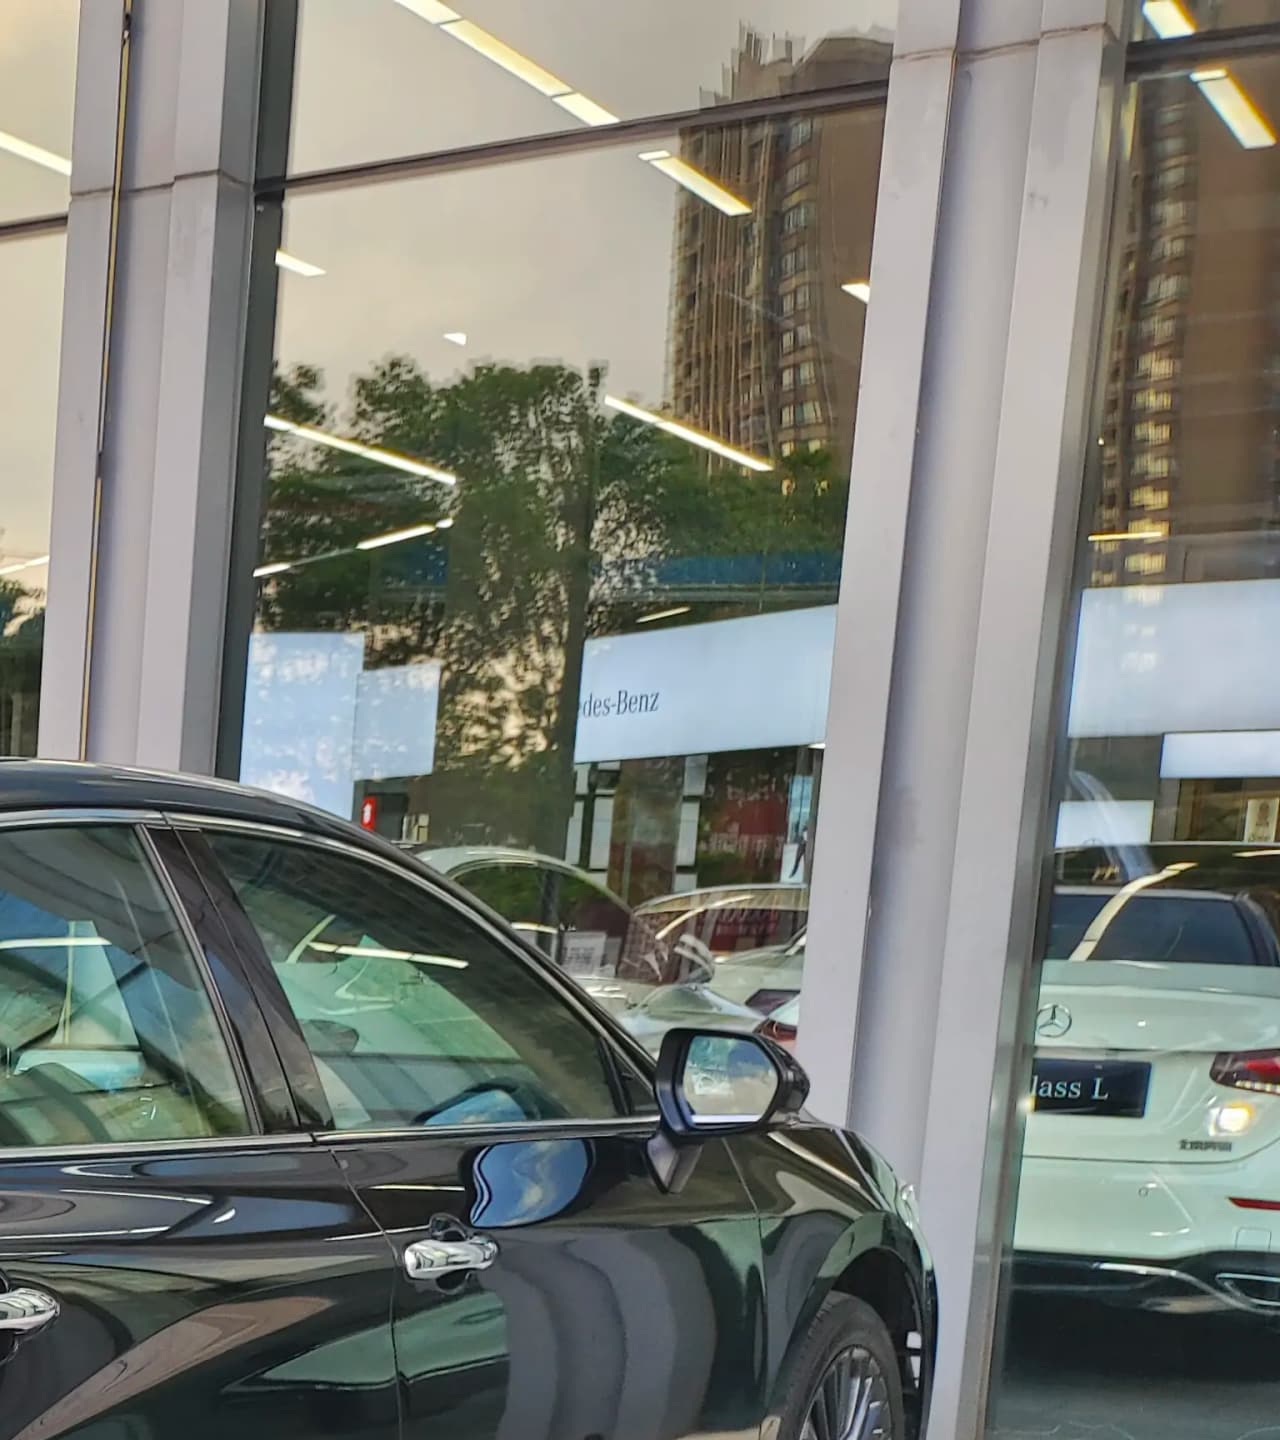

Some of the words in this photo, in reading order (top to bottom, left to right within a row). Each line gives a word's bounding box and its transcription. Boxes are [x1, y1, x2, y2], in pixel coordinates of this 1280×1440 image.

[581, 689, 660, 718] des-Benz
[1030, 1075, 1081, 1099] lass
[1091, 1077, 1109, 1101] L
